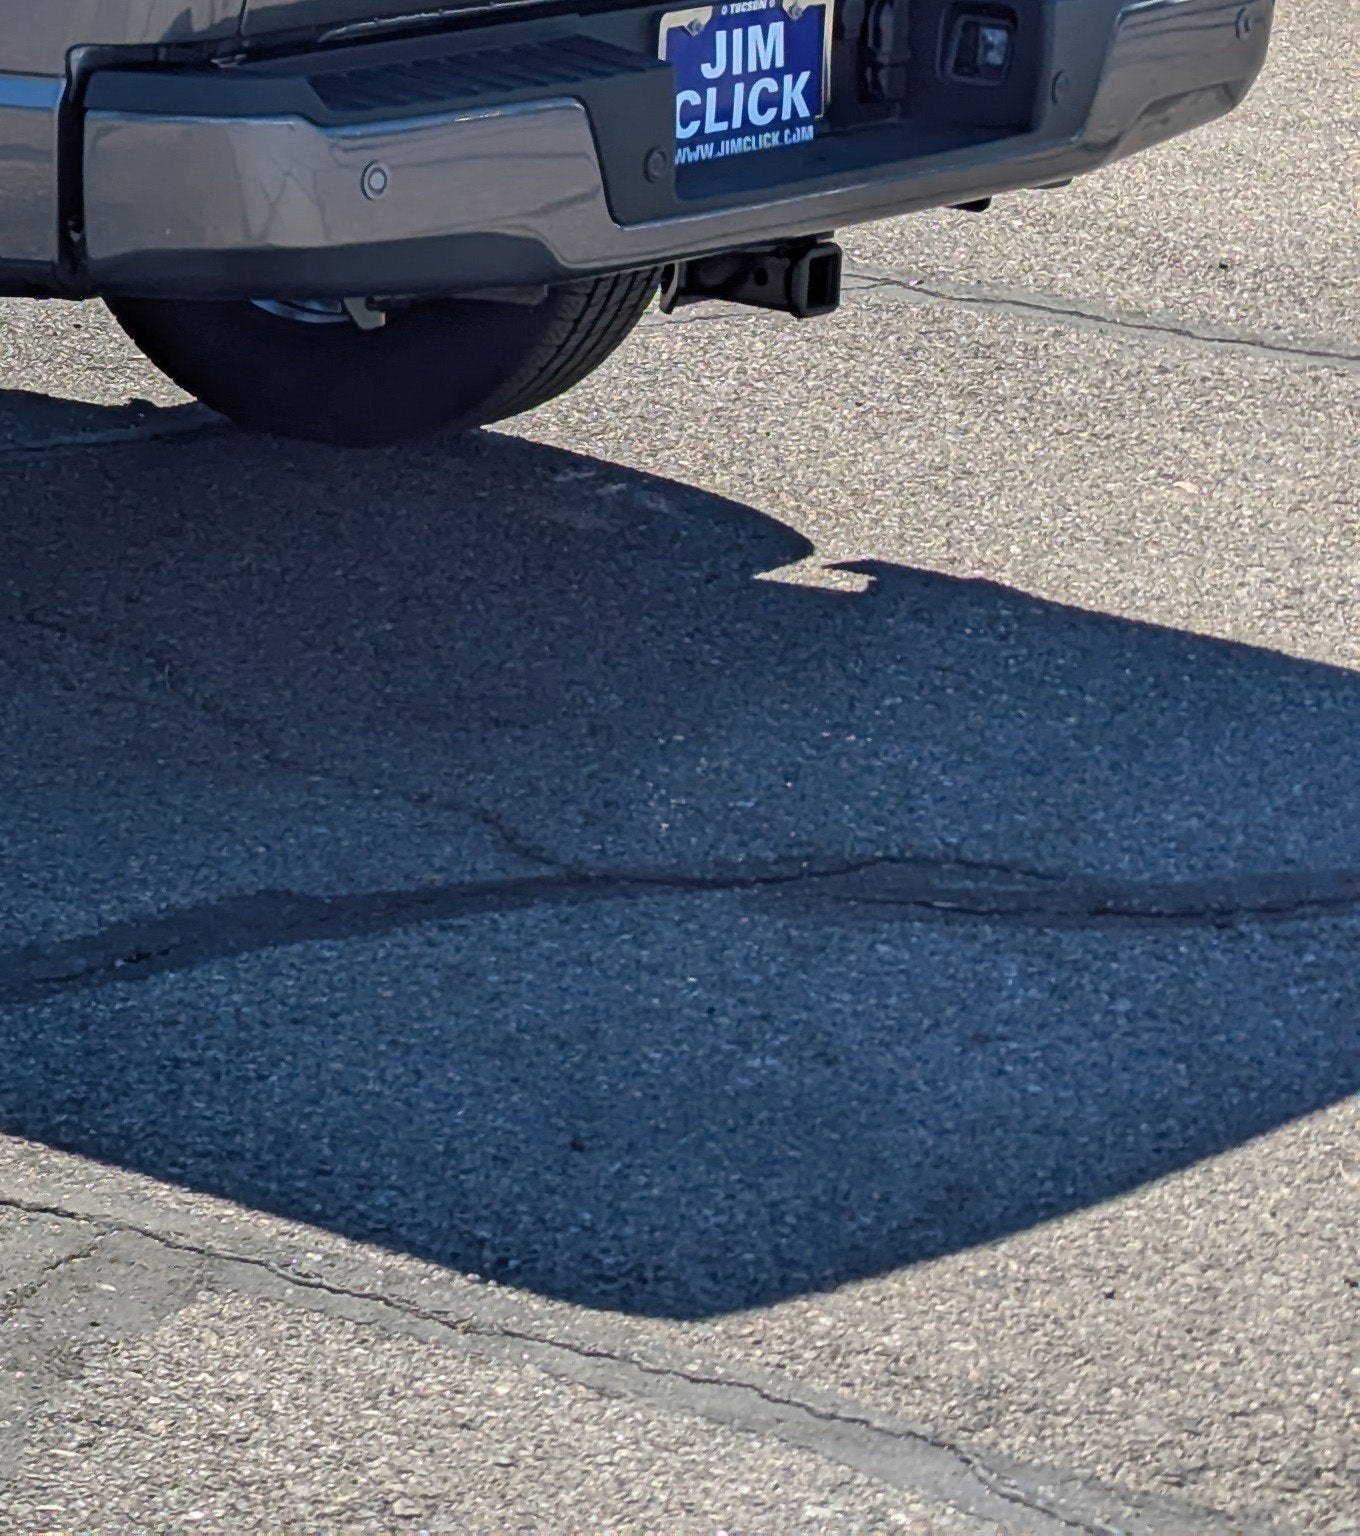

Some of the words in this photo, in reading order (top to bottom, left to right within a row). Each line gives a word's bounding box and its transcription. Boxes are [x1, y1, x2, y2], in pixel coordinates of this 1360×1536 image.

[701, 21, 785, 80] JIM
[675, 71, 812, 139] CLICK
[674, 125, 815, 165] WWW.JIMCLICK.COM
